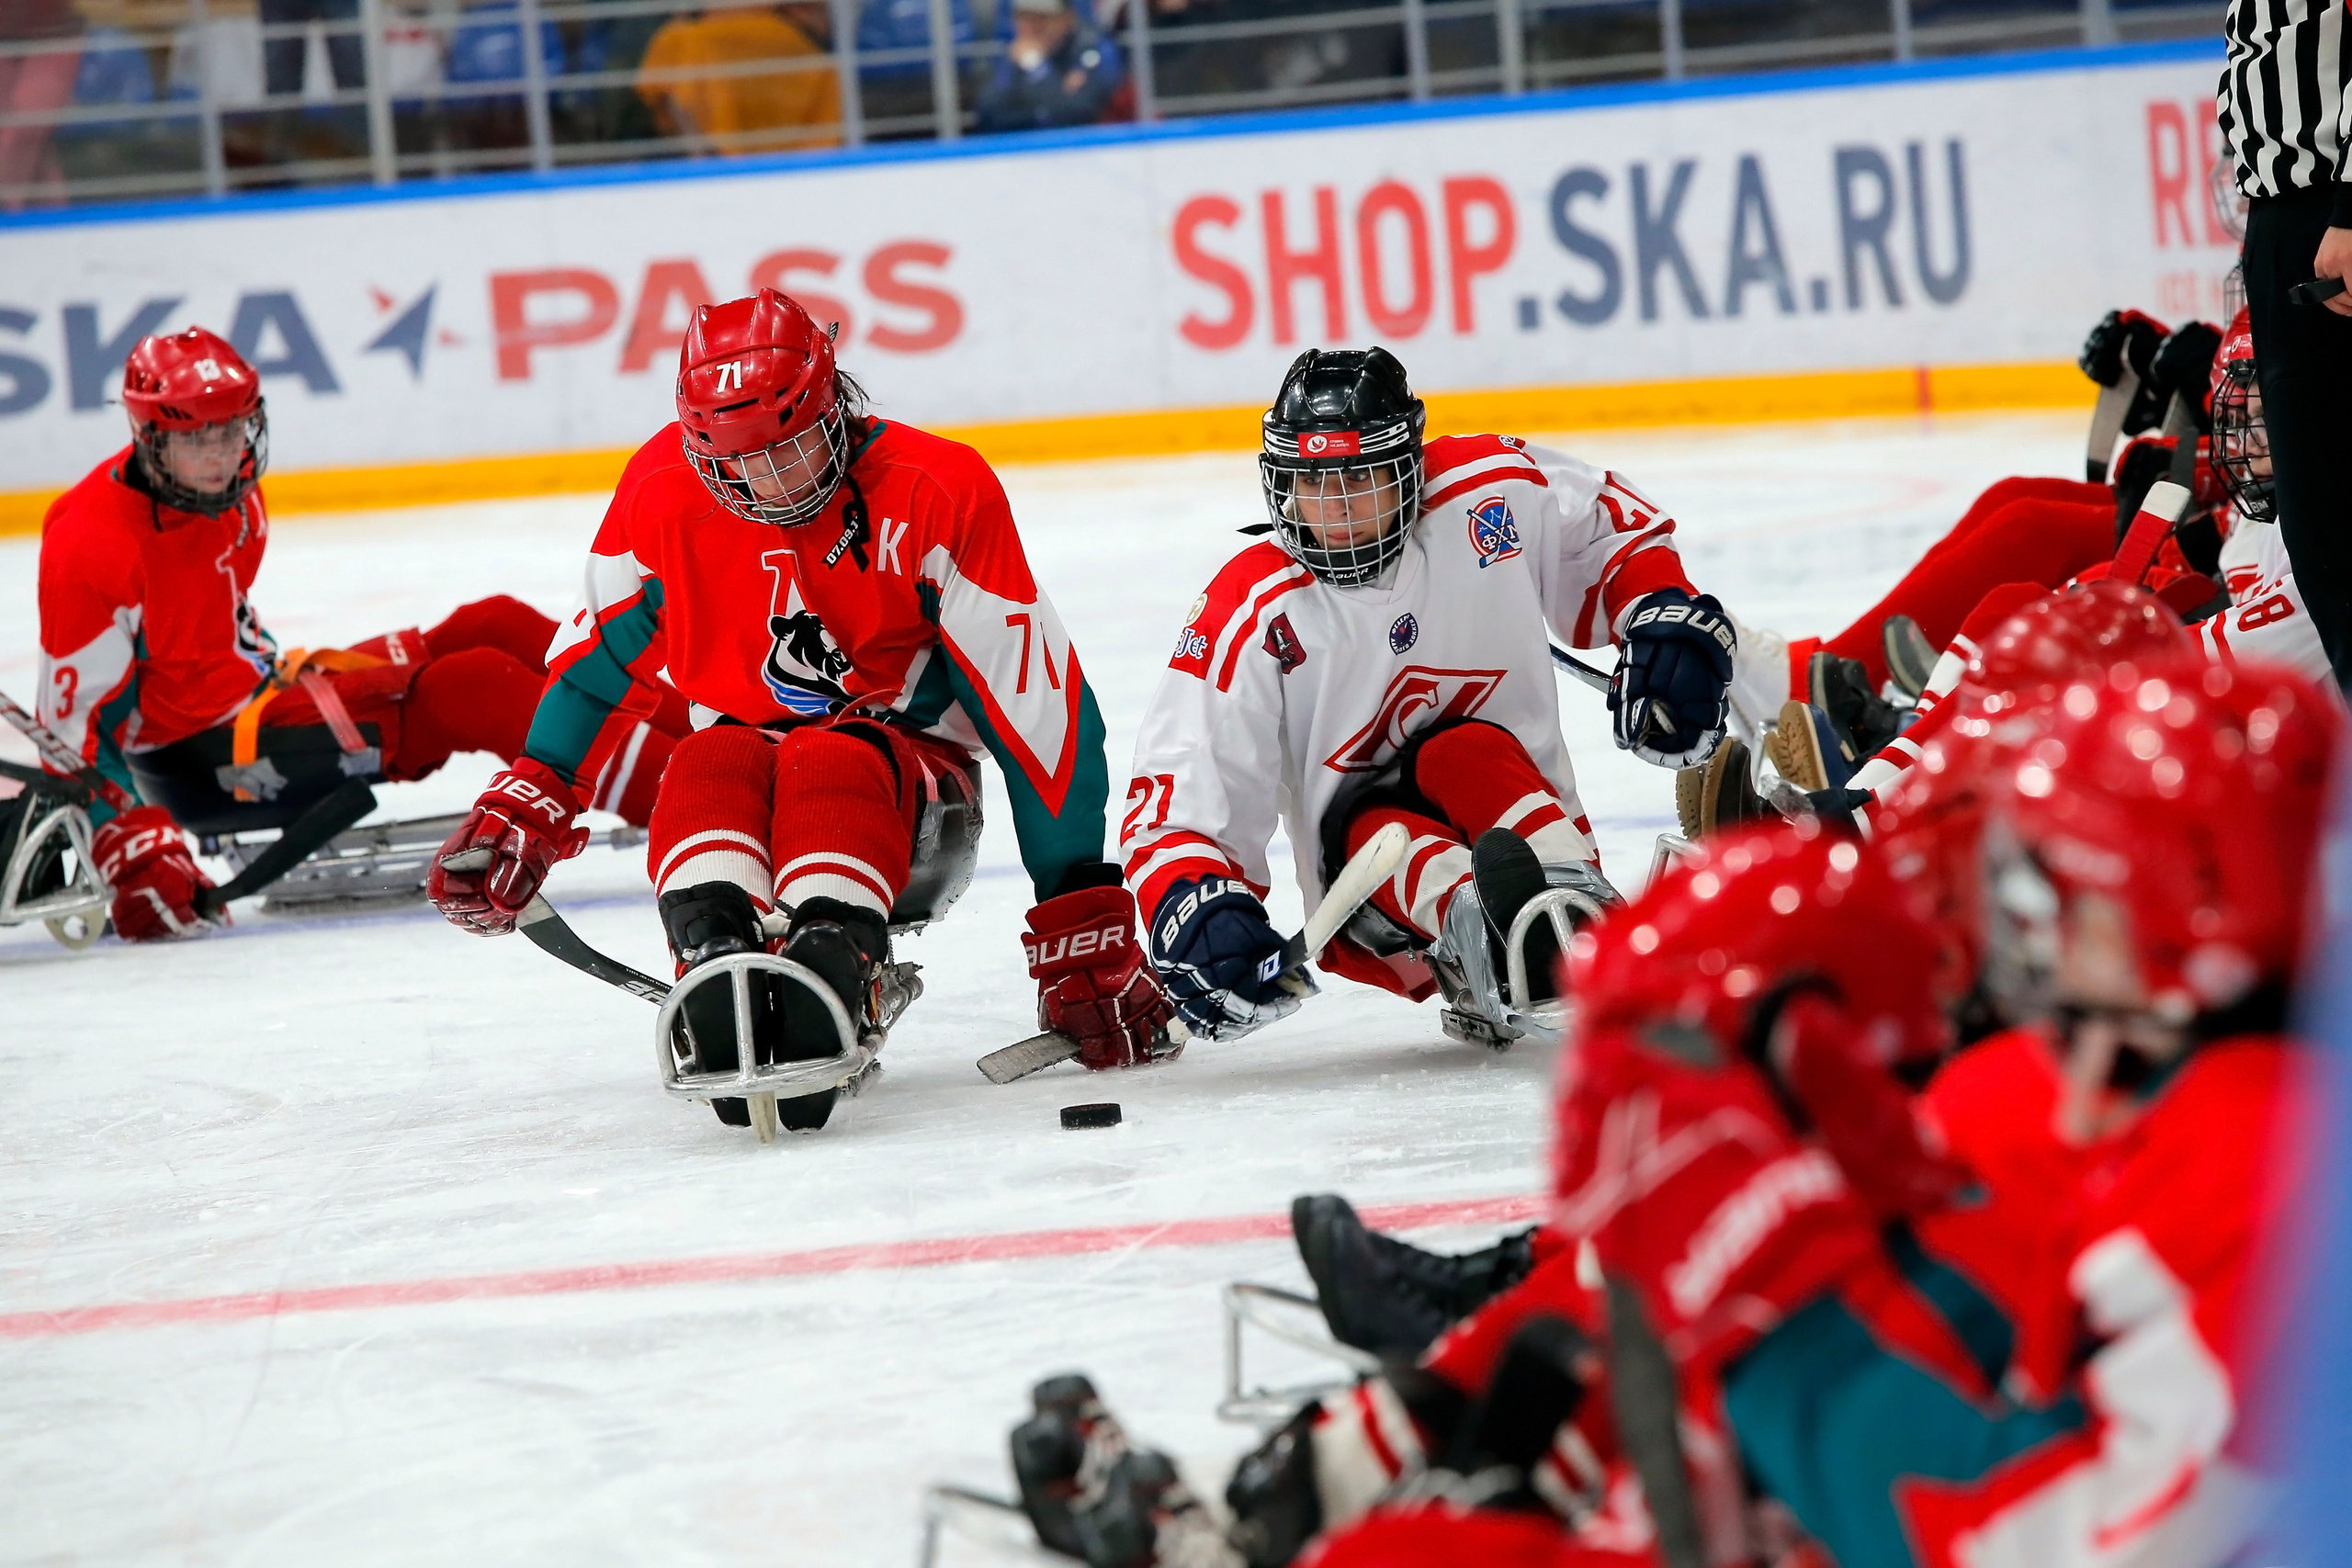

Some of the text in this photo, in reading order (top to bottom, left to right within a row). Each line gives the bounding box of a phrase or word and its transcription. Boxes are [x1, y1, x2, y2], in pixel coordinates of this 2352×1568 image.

[2144, 99, 2238, 246] RE
[1171, 139, 1972, 350] SHOP.SKA.RU
[487, 241, 962, 381] PASS
[717, 360, 742, 393] 71
[826, 515, 858, 564] 07.09.1
[1120, 773, 1174, 848] 21
[1026, 925, 1125, 967] AUER
[1161, 880, 1259, 953] BAUE
